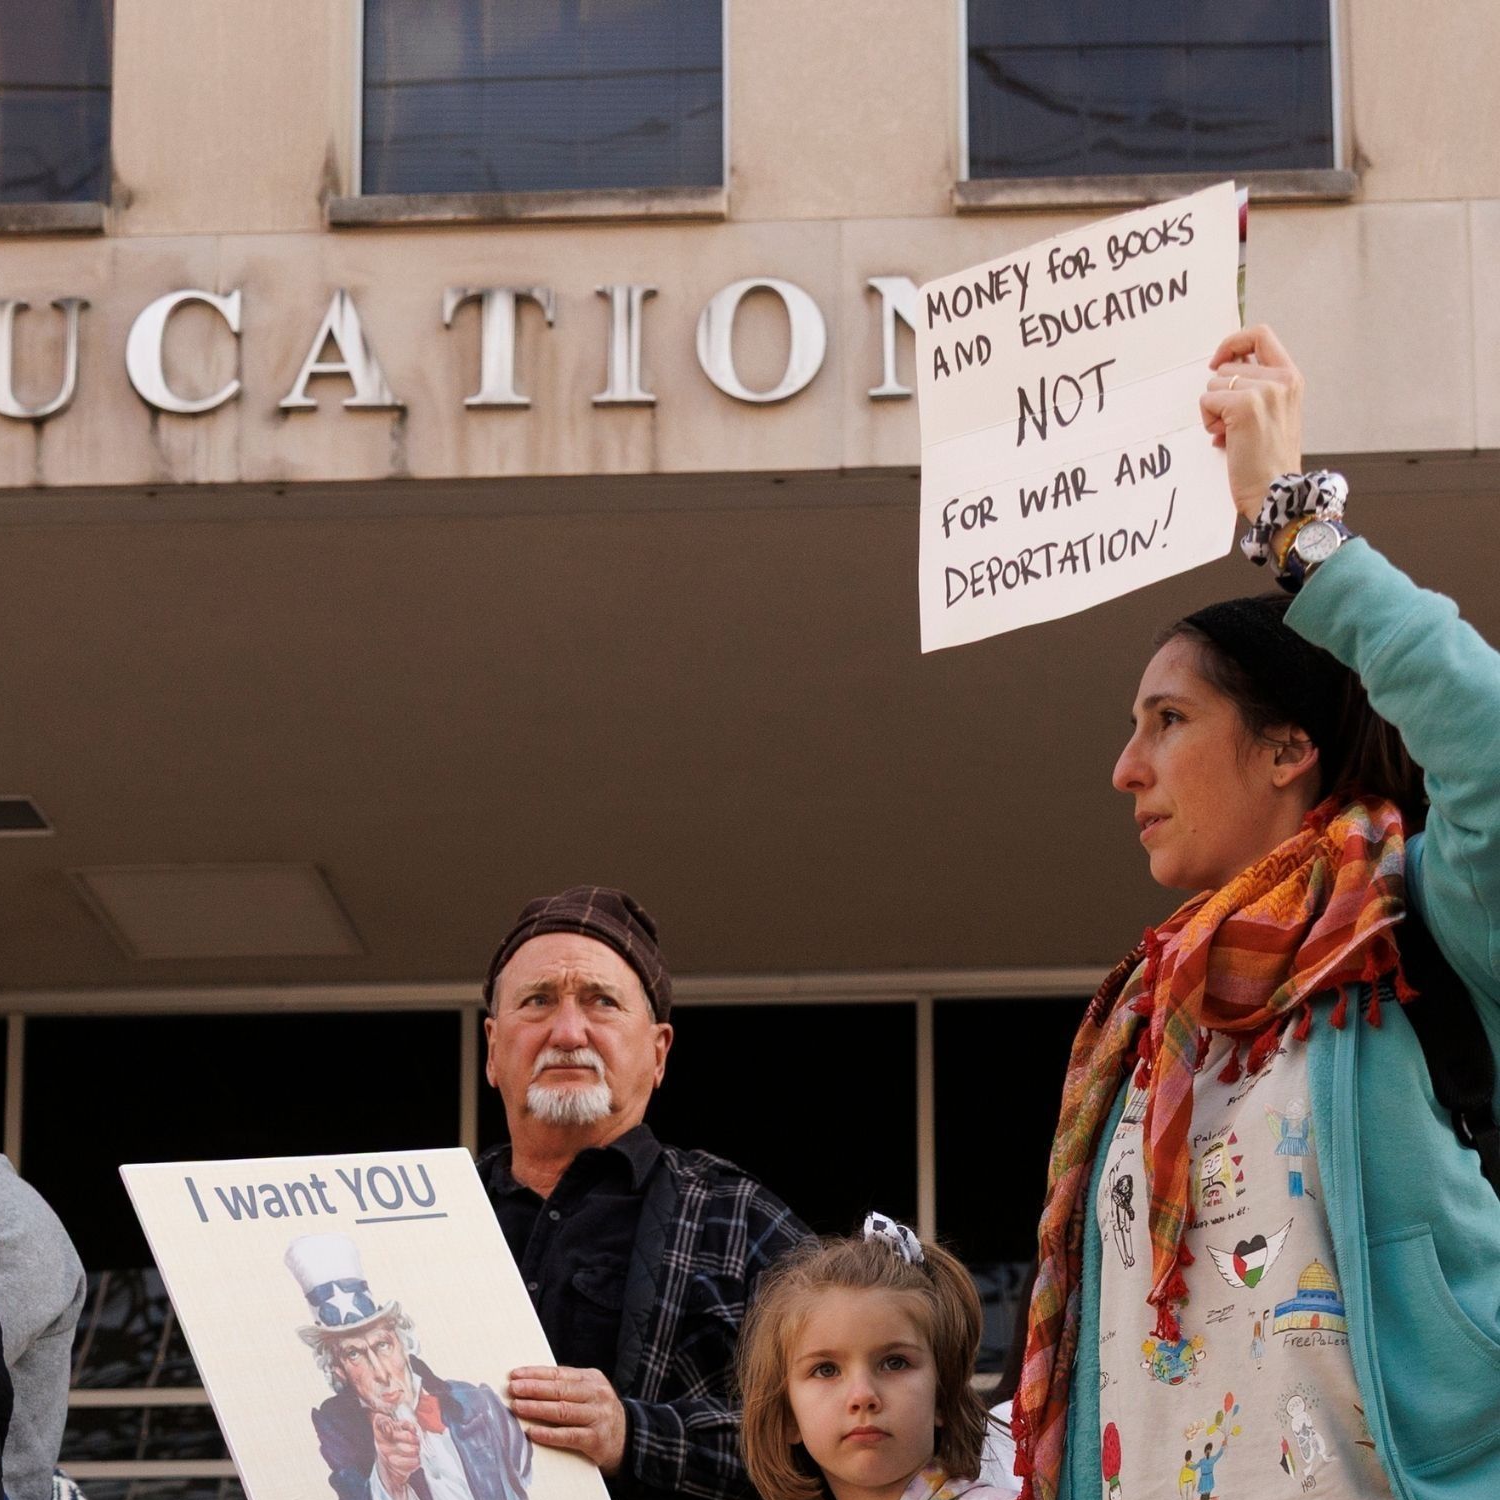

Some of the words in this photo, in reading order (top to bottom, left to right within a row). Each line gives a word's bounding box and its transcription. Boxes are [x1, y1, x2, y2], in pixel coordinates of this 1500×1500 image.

[927, 261, 1031, 329] MONEY
[1047, 246, 1097, 284] FOR
[1107, 213, 1194, 271] BOOKS
[934, 334, 992, 380] AND
[1020, 269, 1189, 348] EDUCATION
[1016, 359, 1116, 447] NOT
[942, 495, 999, 539] FOR
[1019, 466, 1098, 519] WAR
[1114, 443, 1173, 487] AND
[945, 487, 1177, 608] DEPORTATION!
[184, 1176, 209, 1222] I
[214, 1173, 338, 1221] want
[334, 1164, 436, 1212] YOU
